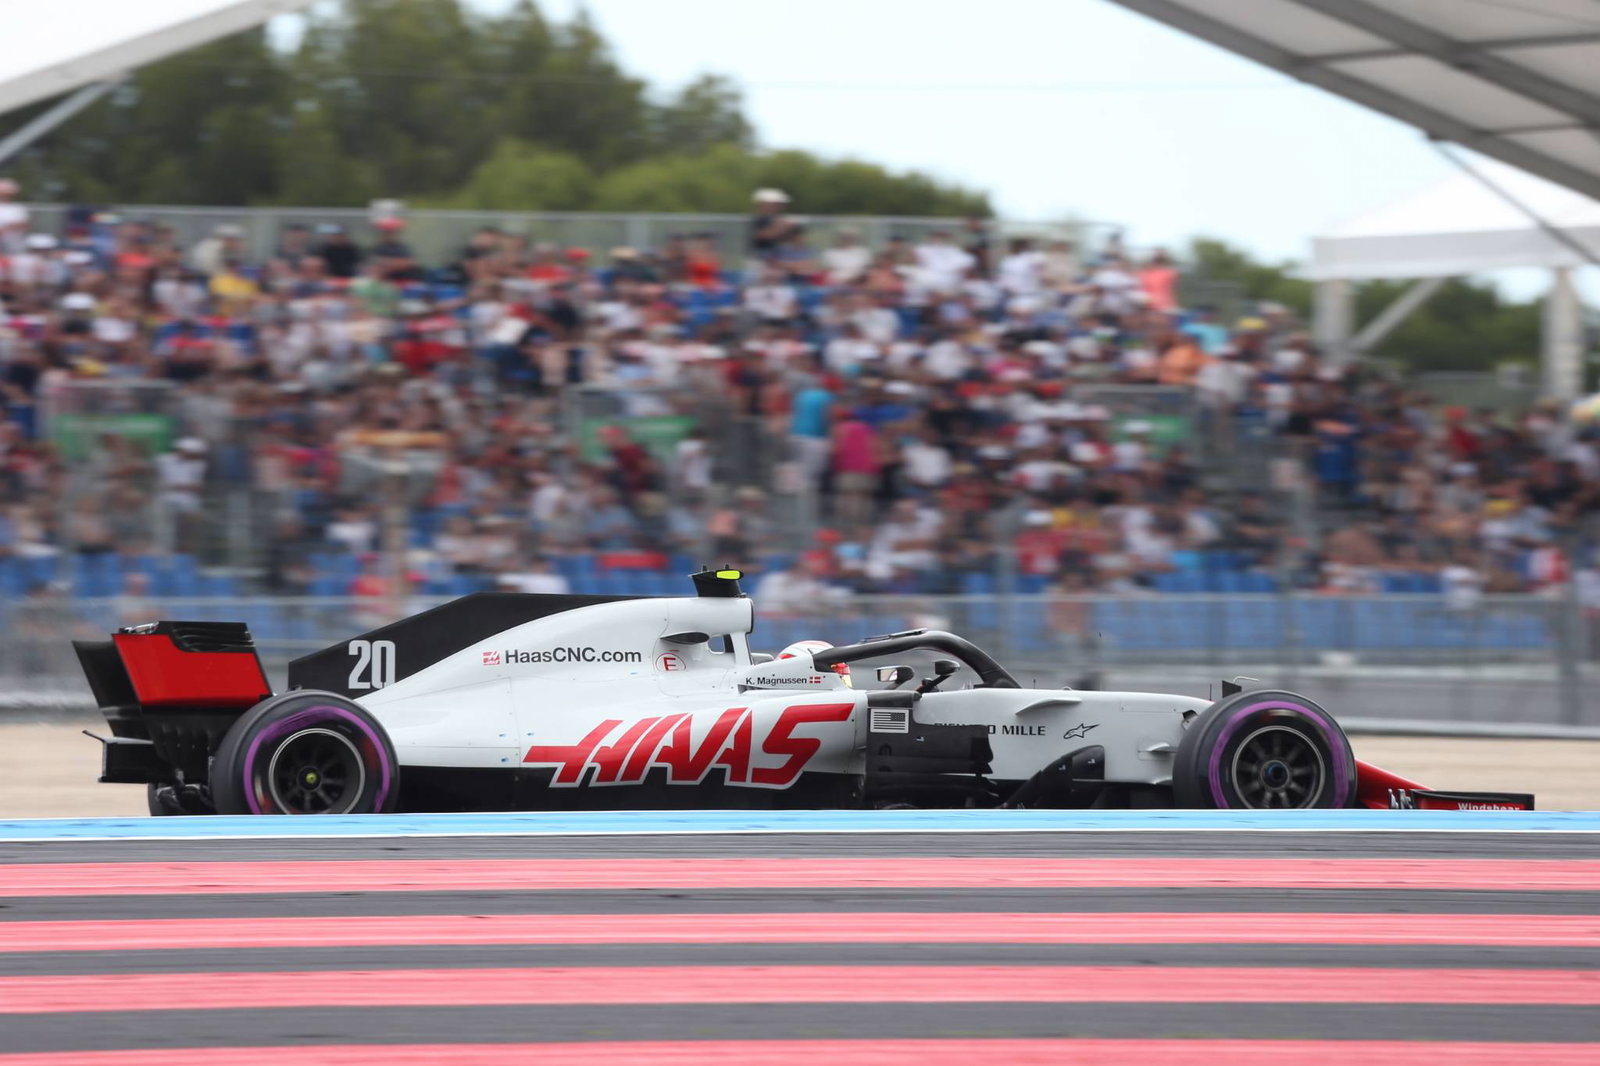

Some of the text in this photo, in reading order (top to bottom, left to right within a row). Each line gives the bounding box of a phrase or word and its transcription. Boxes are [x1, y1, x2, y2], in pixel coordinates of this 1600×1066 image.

[505, 647, 643, 664] HaasCNC.com
[663, 656, 677, 671] E
[348, 640, 396, 689] 20
[745, 676, 808, 687] K. Magnussen
[1002, 724, 1046, 736] MILLE
[522, 702, 856, 787] HAAS
